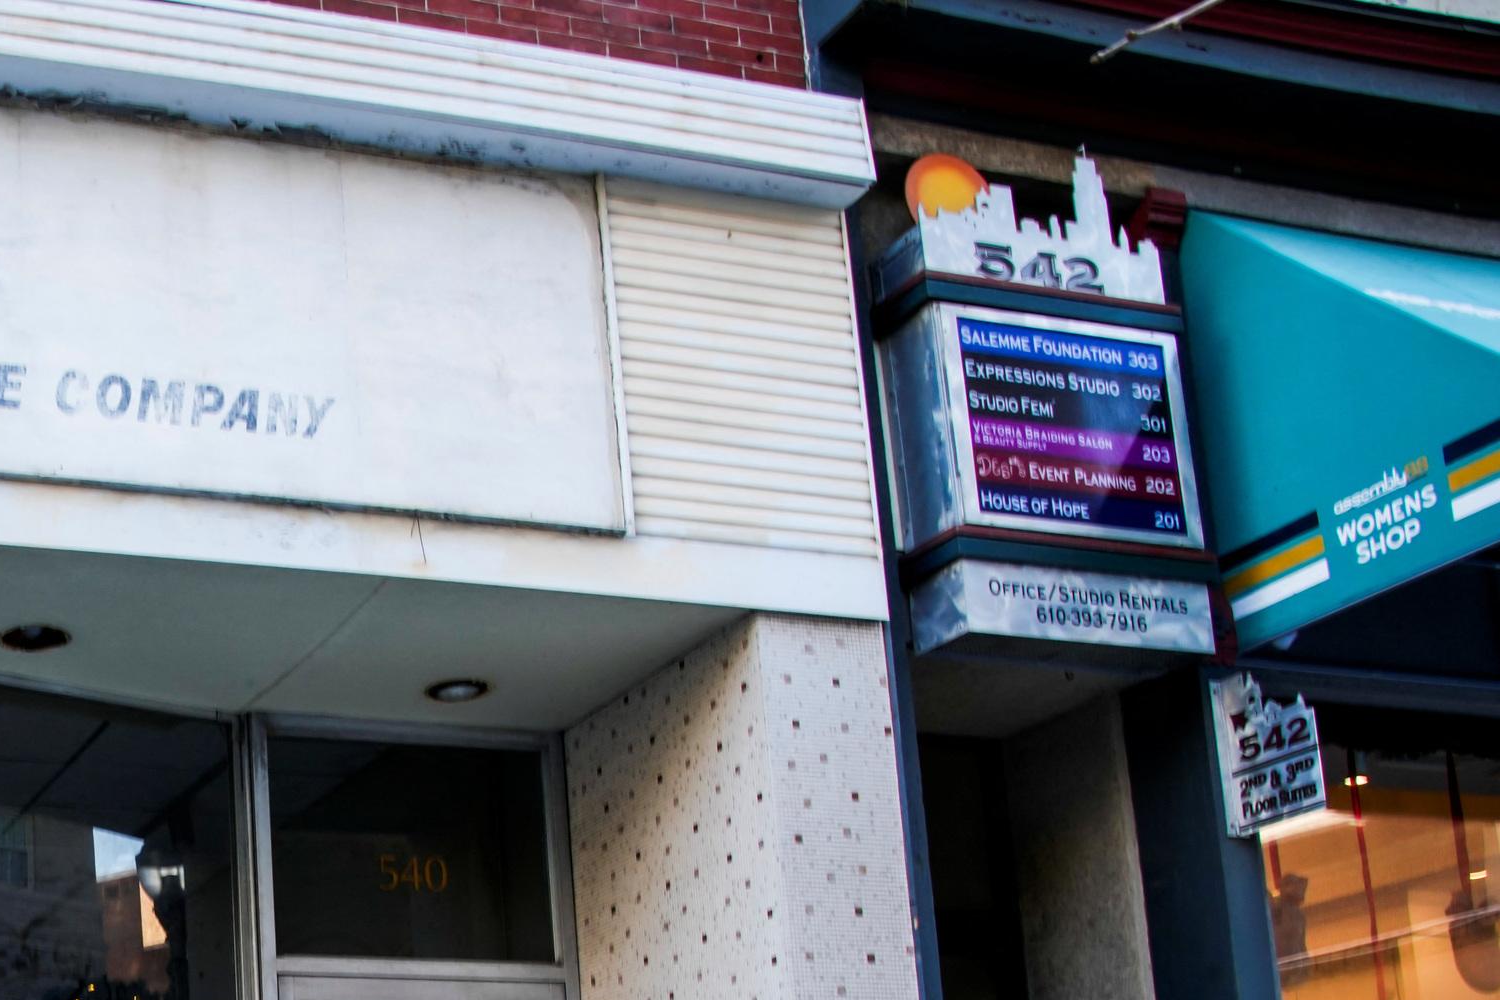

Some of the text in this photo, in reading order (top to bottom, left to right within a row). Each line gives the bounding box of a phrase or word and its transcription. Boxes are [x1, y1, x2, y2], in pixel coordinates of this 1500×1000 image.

[974, 242, 1104, 297] 542
[1033, 335, 1122, 366] FOUNDATION
[1128, 351, 1158, 370] 303
[965, 358, 1162, 402] EXPRESSIONS STUDIO 302
[54, 367, 336, 440] COMPANY
[969, 389, 1019, 414] STUDIO
[1141, 414, 1166, 433] 301
[1142, 445, 1171, 463] 203
[1029, 462, 1070, 484] EVENT
[1074, 467, 1137, 492] PLANNING
[1145, 476, 1176, 496] 202
[980, 489, 1090, 520] HOUSE OF HOPE
[1155, 511, 1180, 530] 201
[1336, 483, 1437, 547] WOMENS
[1356, 517, 1421, 565] SHOP
[1119, 590, 1189, 616] RENTALS
[1239, 717, 1311, 761] 542
[1240, 773, 1267, 799] 2ND
[1285, 757, 1315, 785] 3RD
[1241, 796, 1278, 820] FLOOR
[379, 852, 449, 894] 540
